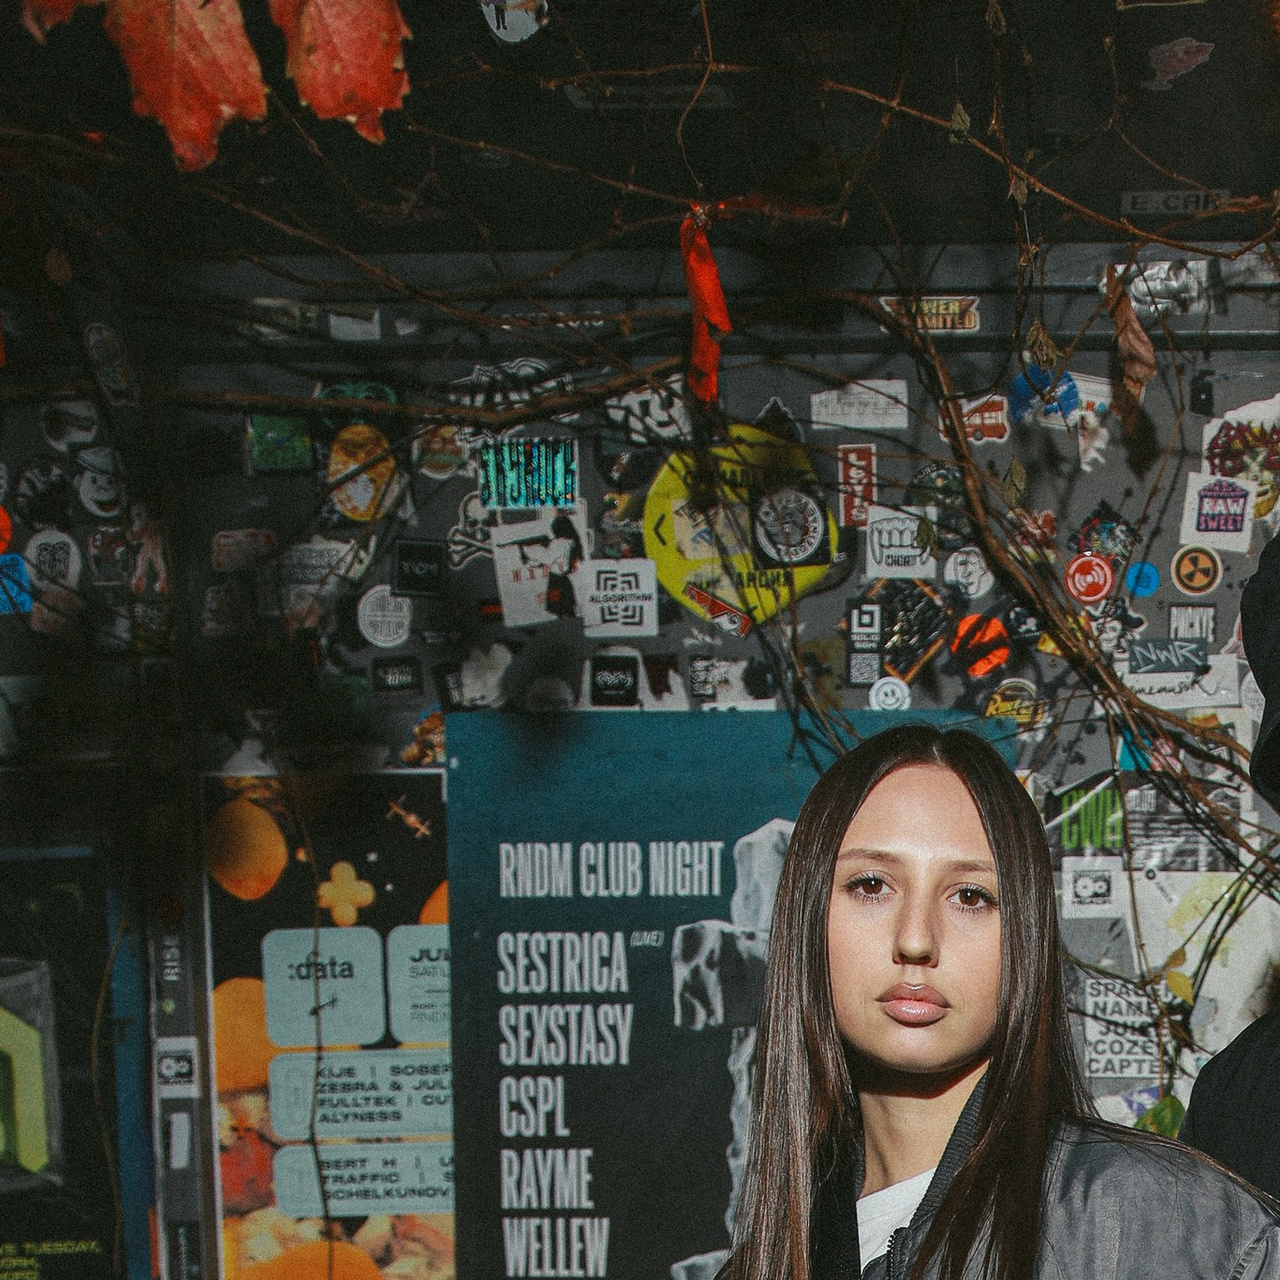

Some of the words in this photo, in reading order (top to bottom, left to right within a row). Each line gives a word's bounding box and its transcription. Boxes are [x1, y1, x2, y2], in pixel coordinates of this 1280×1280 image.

[1198, 514, 1244, 530] SWEET
[1201, 496, 1245, 515] RAW
[499, 842, 573, 898] RNDM
[579, 841, 643, 897] CLUB
[649, 840, 724, 897] NIGHT
[497, 931, 629, 994] SESTRICA
[498, 1003, 634, 1066] SEXSTASY
[500, 1075, 571, 1138] CSPL
[501, 1148, 595, 1210] RAYME
[502, 1217, 611, 1278] WELLEW
